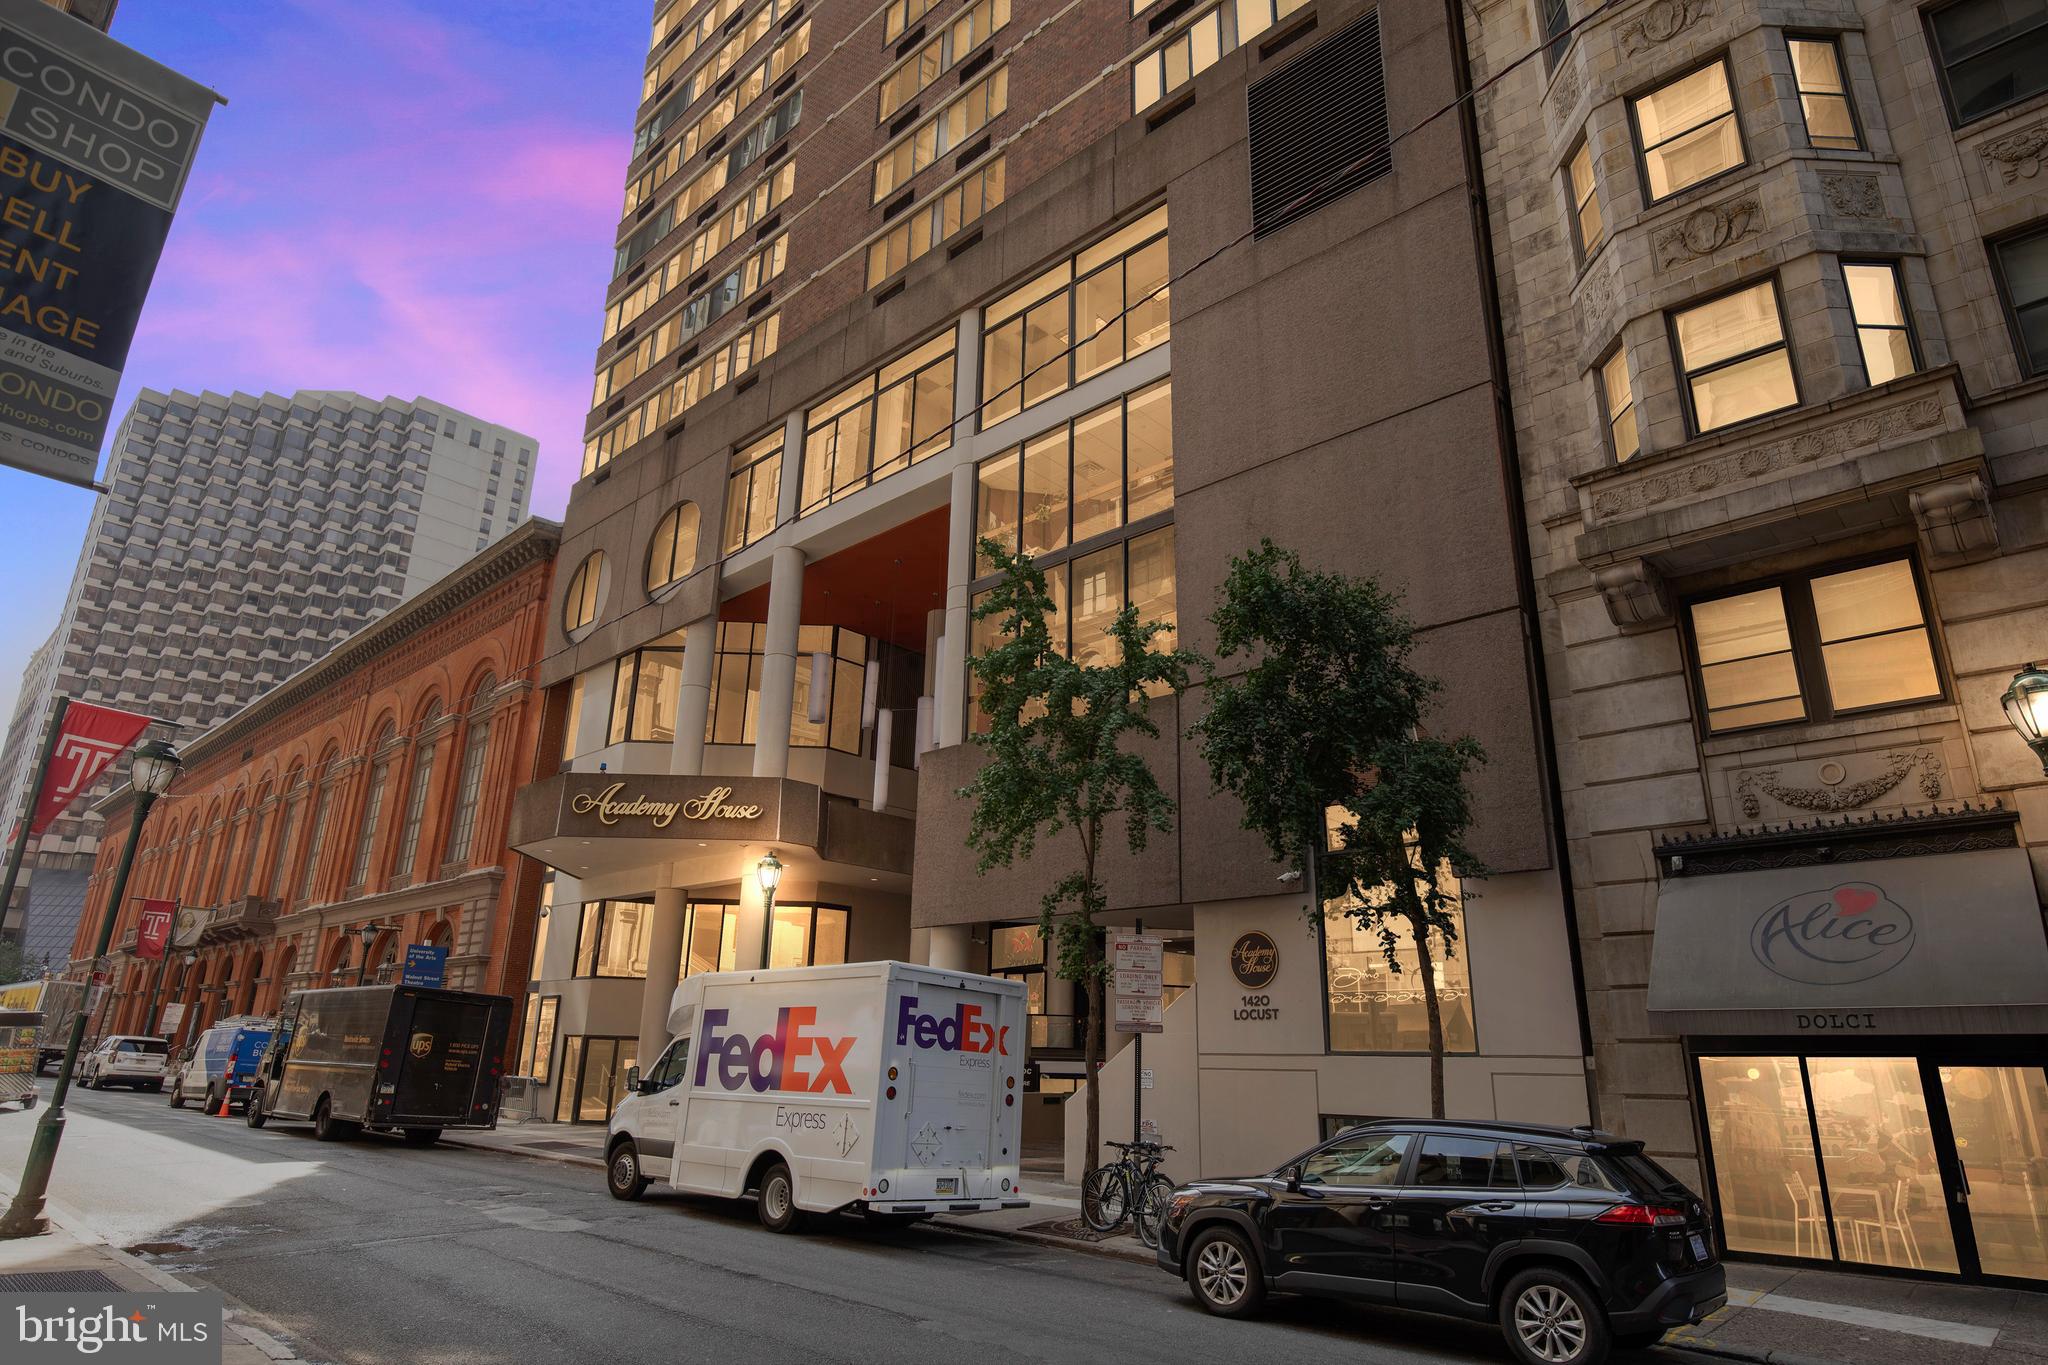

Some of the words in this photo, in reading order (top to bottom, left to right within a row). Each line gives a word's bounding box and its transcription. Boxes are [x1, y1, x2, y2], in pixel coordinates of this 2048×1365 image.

[2, 45, 180, 149] CONDO
[24, 106, 166, 183] SHOP
[0, 146, 94, 204] BUY
[0, 192, 81, 253] ELL
[0, 239, 80, 290] ENT
[0, 287, 101, 349] AGE
[11, 335, 27, 348] in
[31, 342, 56, 359] the
[4, 348, 37, 364] and
[39, 358, 104, 390] Suburbs.
[0, 371, 103, 422] ONDO
[0, 401, 95, 442] hops.com
[572, 782, 681, 829] Academy
[683, 785, 764, 821] House
[141, 910, 171, 940] T
[1760, 902, 1900, 964] Alice
[1231, 940, 1278, 964] Academy
[1239, 956, 1273, 975] House
[1233, 1008, 1280, 1021] LOCUST
[1241, 995, 1270, 1007] 1420
[1796, 1013, 1877, 1030] DOLCI
[897, 995, 1010, 1056] FedEx
[411, 1040, 431, 1054] ups
[695, 1006, 858, 1095] FedEx
[959, 1055, 991, 1069] Express
[775, 1106, 827, 1133] Express
